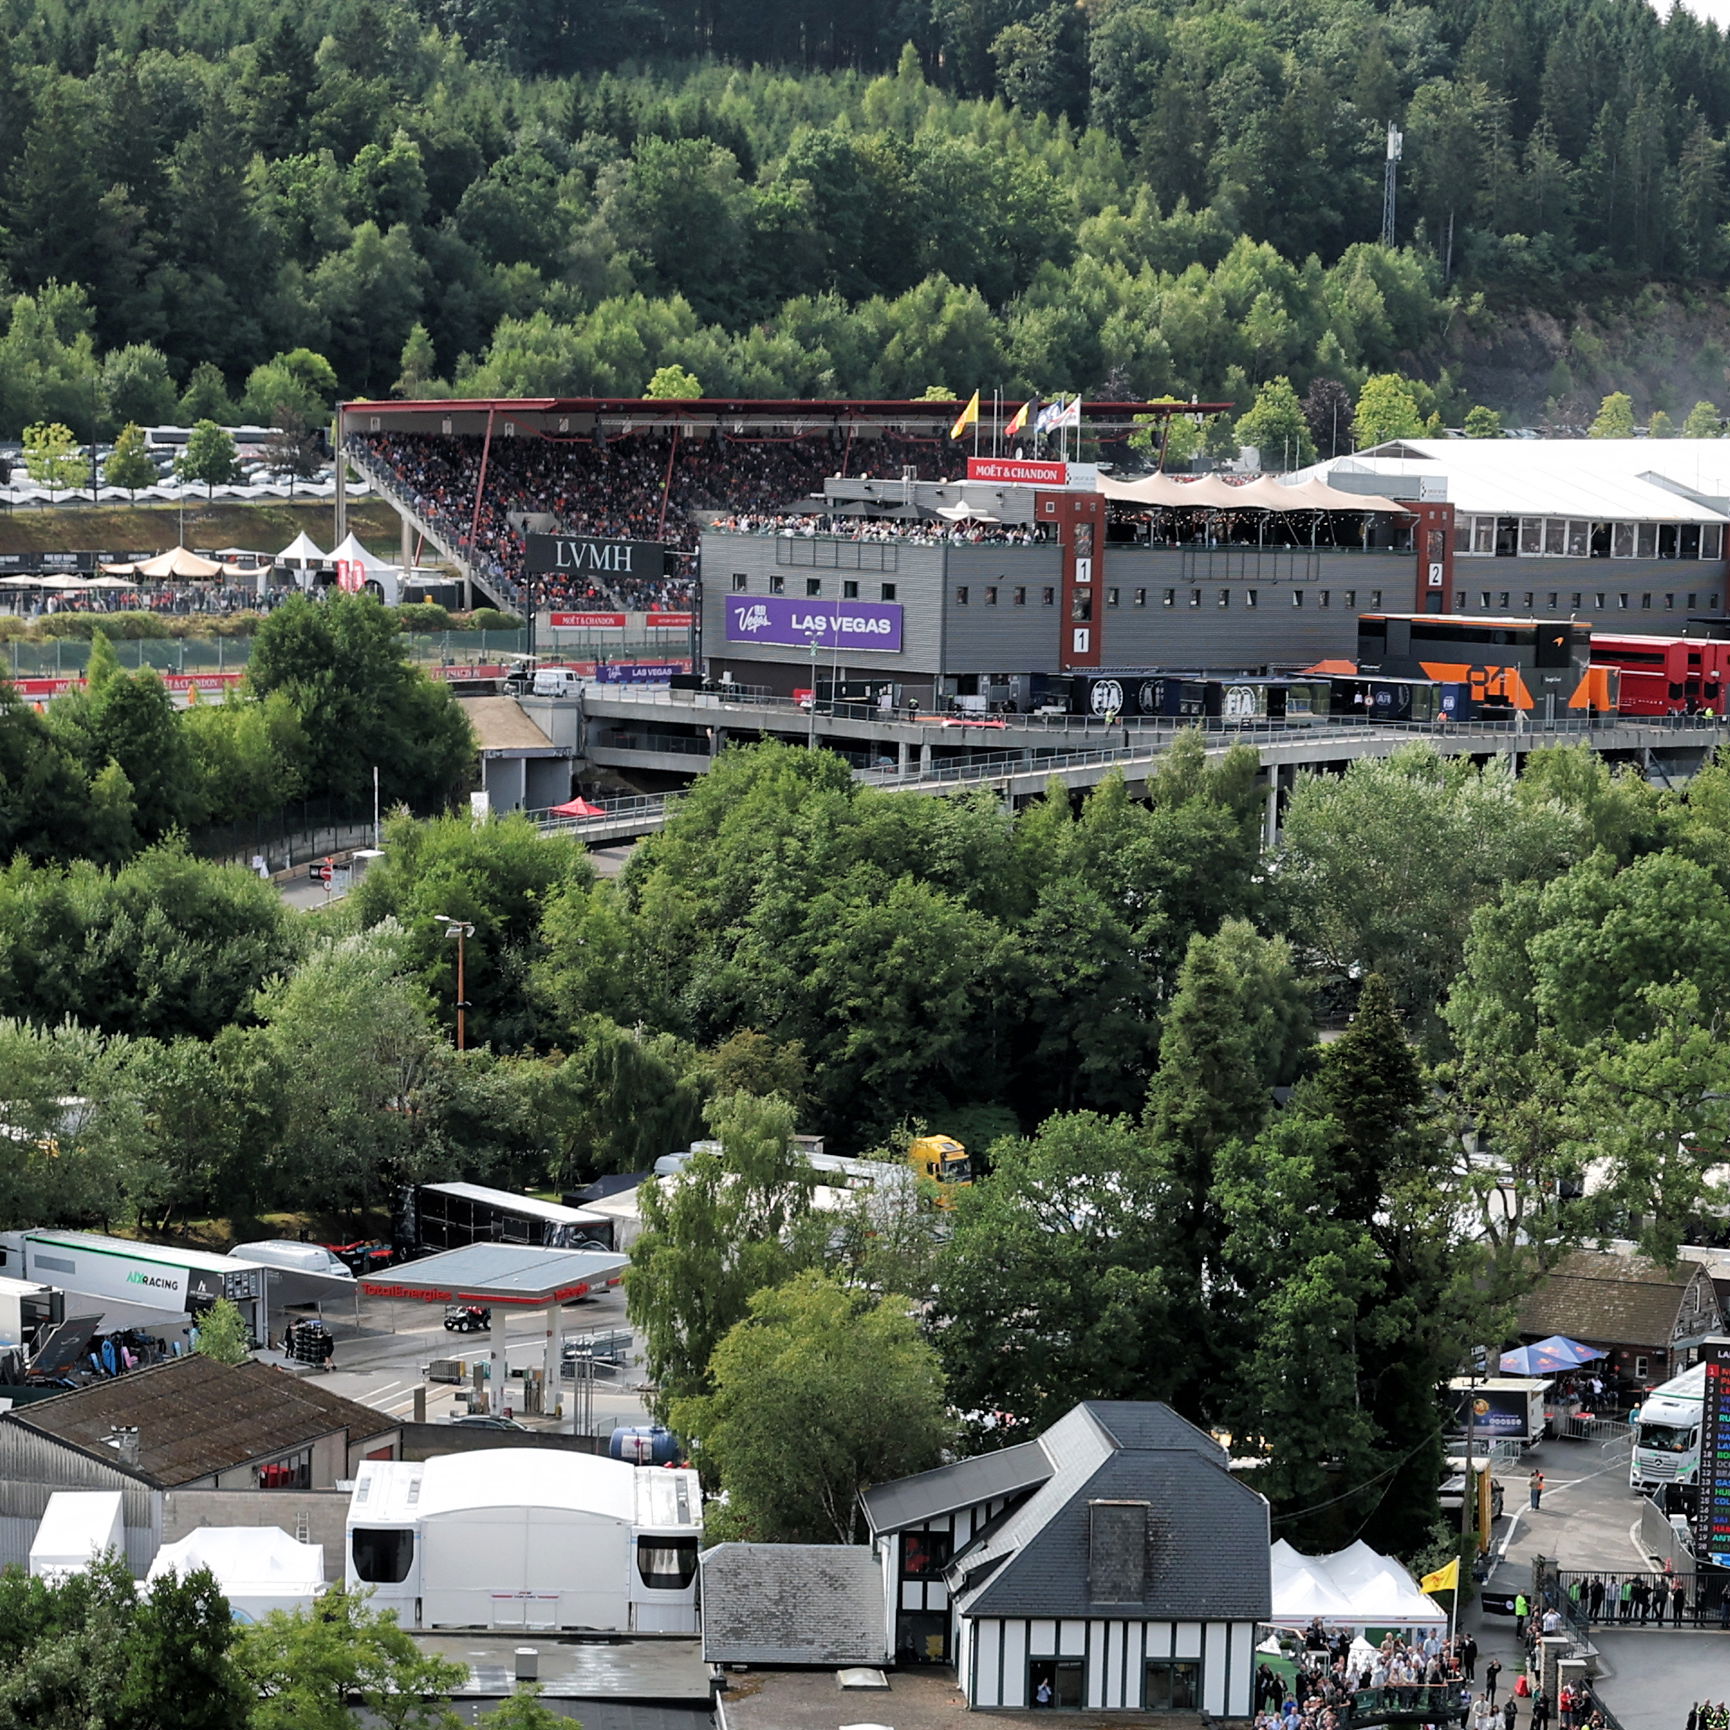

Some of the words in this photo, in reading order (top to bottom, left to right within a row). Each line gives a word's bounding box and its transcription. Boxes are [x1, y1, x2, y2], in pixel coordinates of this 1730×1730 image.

[976, 465, 1003, 477] MOËT
[1003, 467, 1010, 477] &
[1011, 467, 1058, 481] CHANDON
[555, 541, 633, 572] LVMH
[1432, 565, 1440, 584] 2
[585, 617, 615, 625] CHANDON
[791, 614, 827, 631] LAS
[829, 616, 892, 634] VEGAS
[632, 668, 645, 677] LAS
[646, 668, 672, 677] VEGAS
[1093, 688, 1120, 709] FIA
[1226, 693, 1256, 716] FIA
[361, 1282, 452, 1302] TotalEnergies
